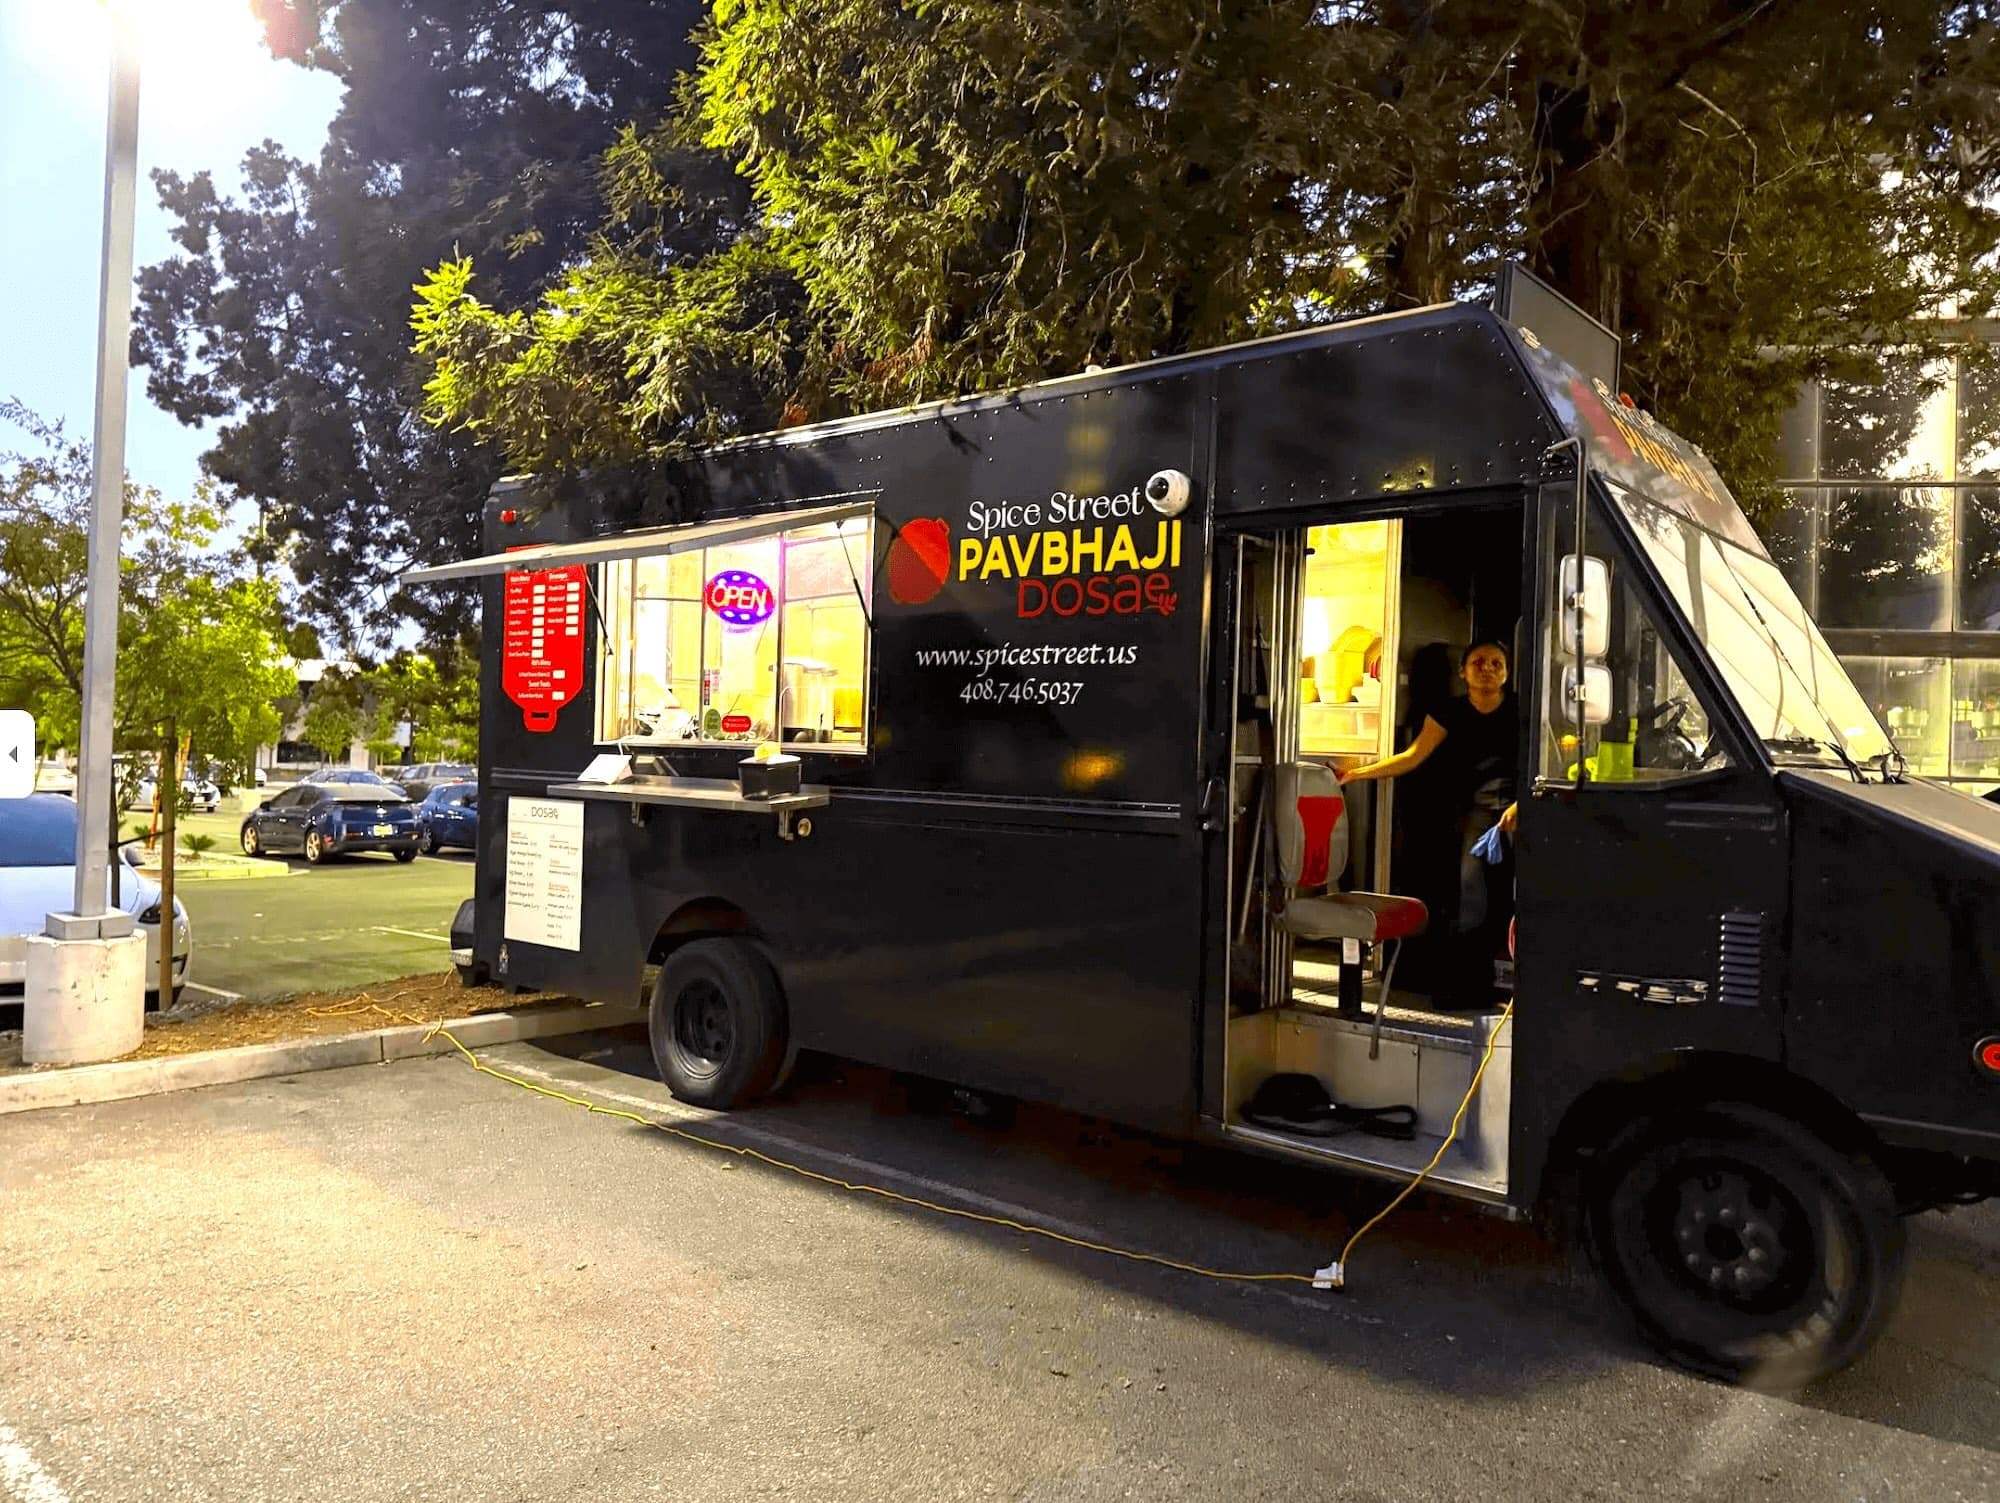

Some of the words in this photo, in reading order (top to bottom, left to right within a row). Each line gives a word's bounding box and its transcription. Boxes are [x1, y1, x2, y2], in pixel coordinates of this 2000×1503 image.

[967, 500, 1041, 539] Spice
[1048, 486, 1144, 524] Street
[958, 519, 1182, 581] PAVBHAJI
[711, 585, 768, 611] OPEN
[915, 641, 1138, 677] www.spicestreet.us
[960, 678, 1084, 704] 408.746.5037
